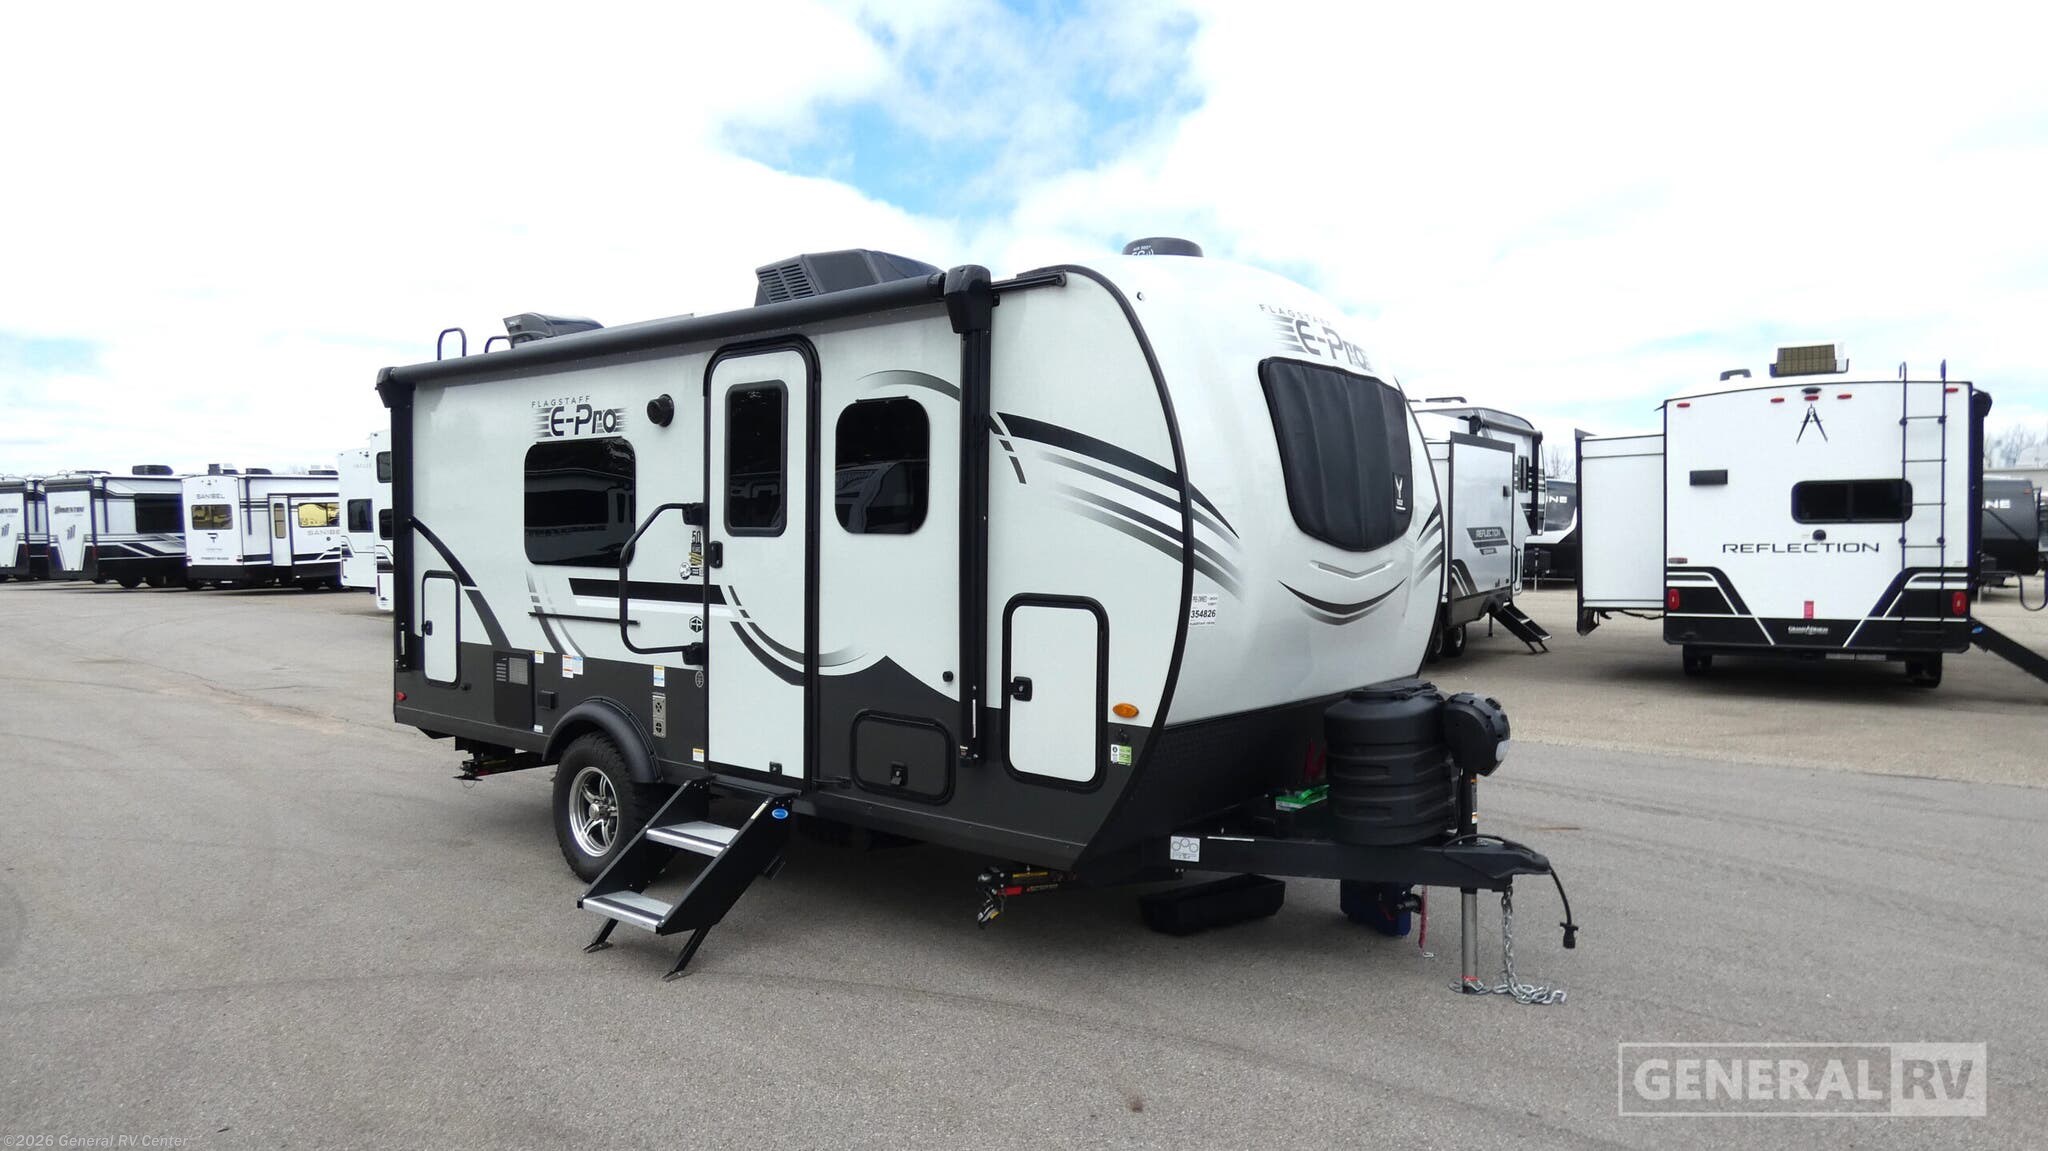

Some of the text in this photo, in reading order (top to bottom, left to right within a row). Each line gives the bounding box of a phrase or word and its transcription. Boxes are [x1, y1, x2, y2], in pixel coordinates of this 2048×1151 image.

[1259, 304, 1331, 326] FLAGSTAFF
[532, 395, 590, 408] FLAGSTAFF
[551, 404, 617, 436] E-Pro
[1723, 543, 1879, 553] REFLECTION
[1191, 609, 1216, 618] 354826
